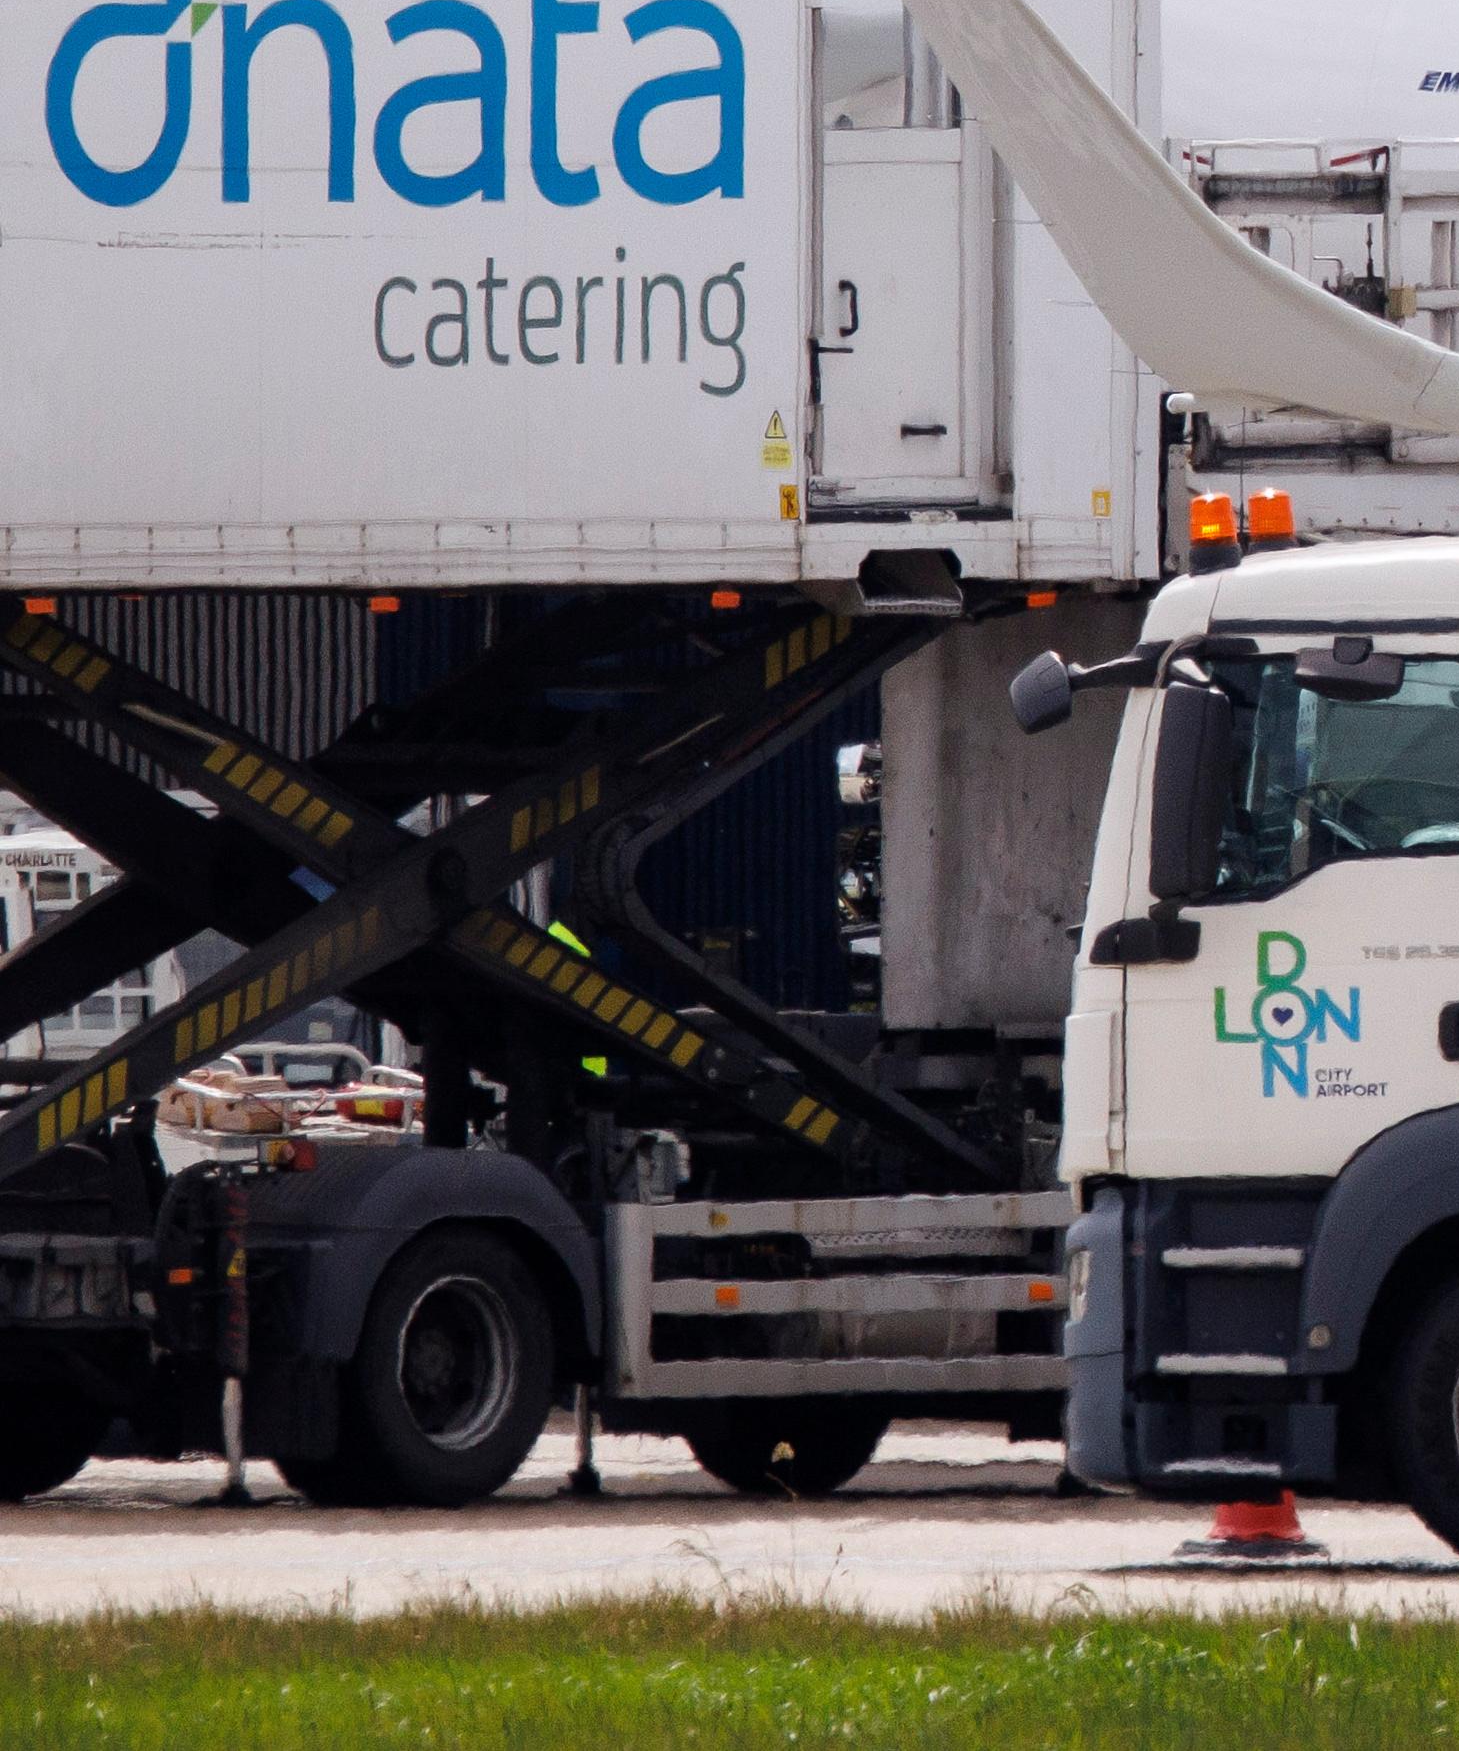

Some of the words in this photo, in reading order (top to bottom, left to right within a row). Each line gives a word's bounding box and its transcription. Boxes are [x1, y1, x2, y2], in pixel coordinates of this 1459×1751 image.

[374, 246, 747, 398] catering
[1314, 1068, 1353, 1083] CITY
[1316, 1082, 1388, 1098] AIRPORT
